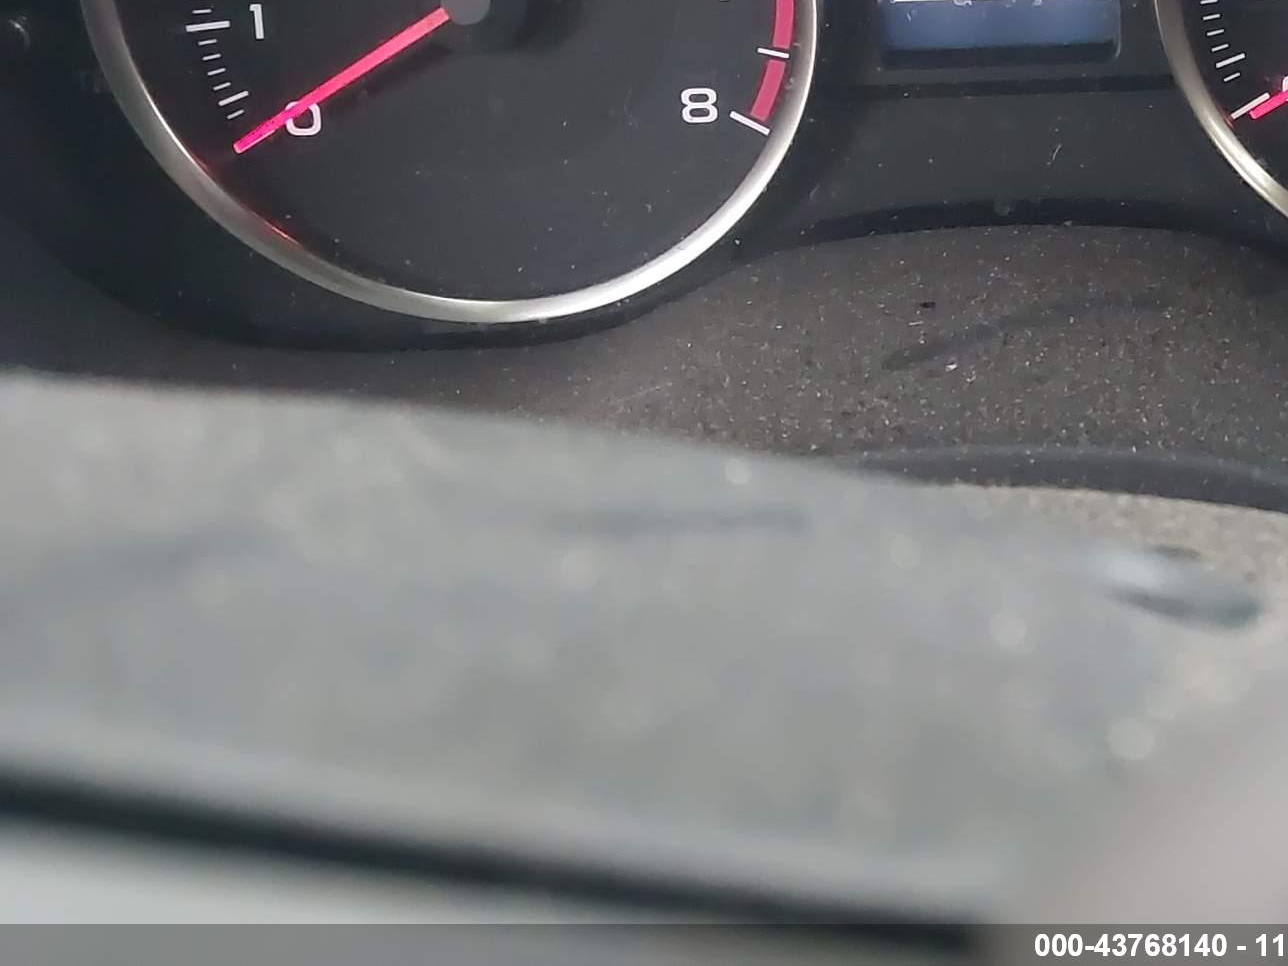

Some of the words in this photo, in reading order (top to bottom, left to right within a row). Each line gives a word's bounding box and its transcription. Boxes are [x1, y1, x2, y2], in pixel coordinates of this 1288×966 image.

[249, 3, 265, 40] 1
[285, 100, 322, 136] 0
[680, 87, 718, 124] 8
